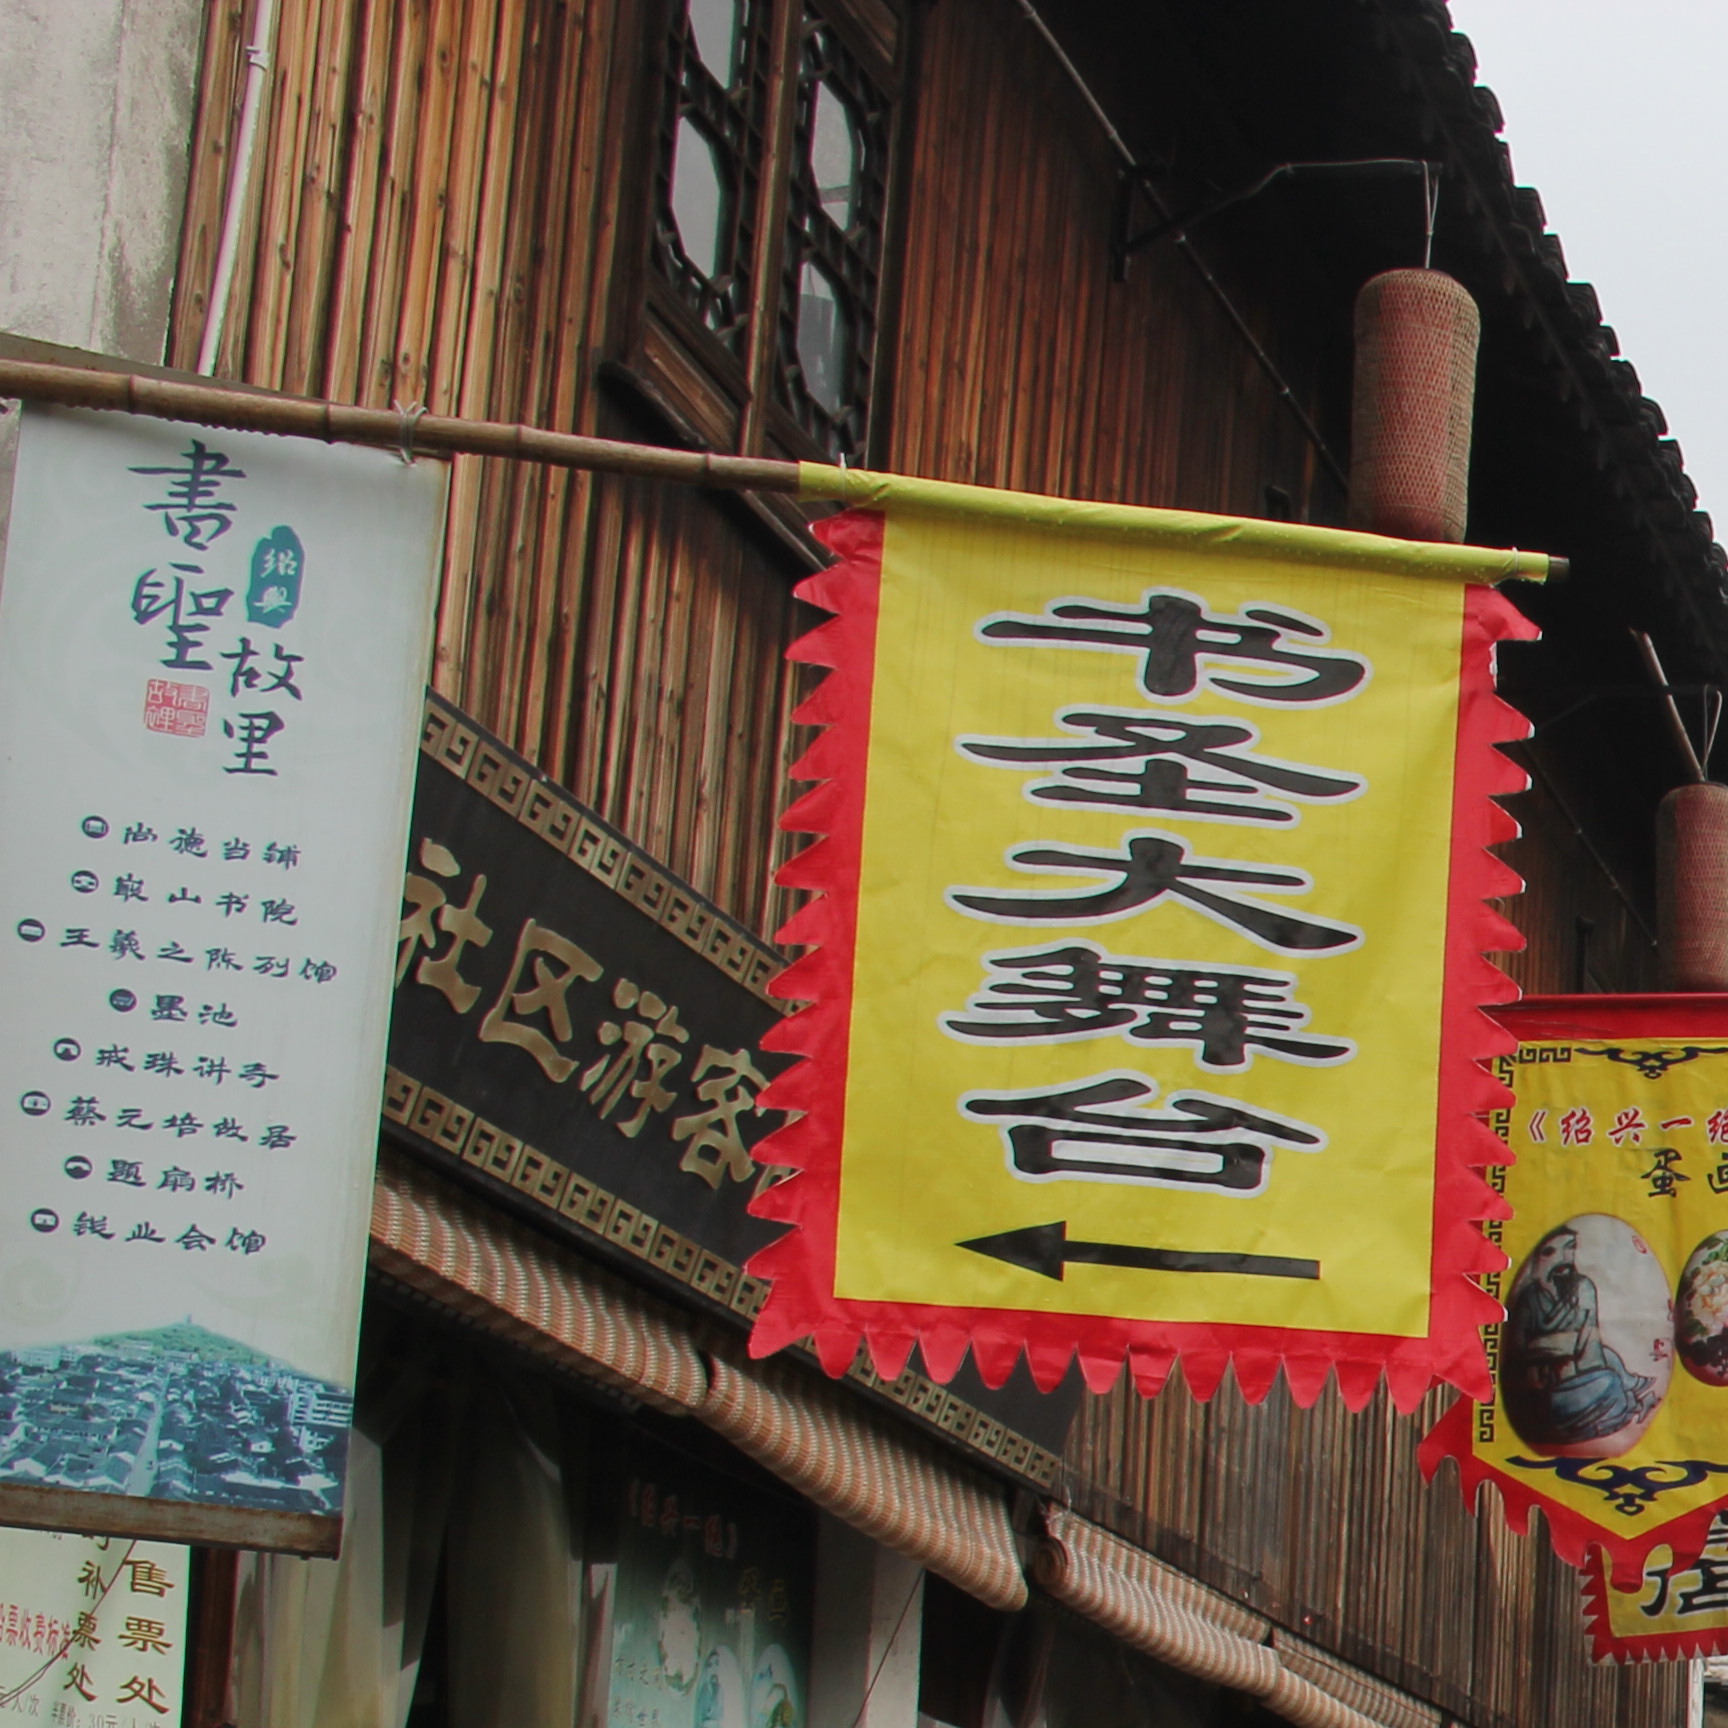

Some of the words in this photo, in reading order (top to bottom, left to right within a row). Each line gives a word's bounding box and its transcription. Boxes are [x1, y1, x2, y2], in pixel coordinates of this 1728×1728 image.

[219, 636, 304, 777] 故里
[940, 588, 1372, 1197] 书圣大舞台
[150, 994, 240, 1029] 墨池
[395, 838, 800, 1192] 社区游客
[65, 1096, 297, 1151] 蔡元培故居
[117, 1559, 175, 1715] 售票处
